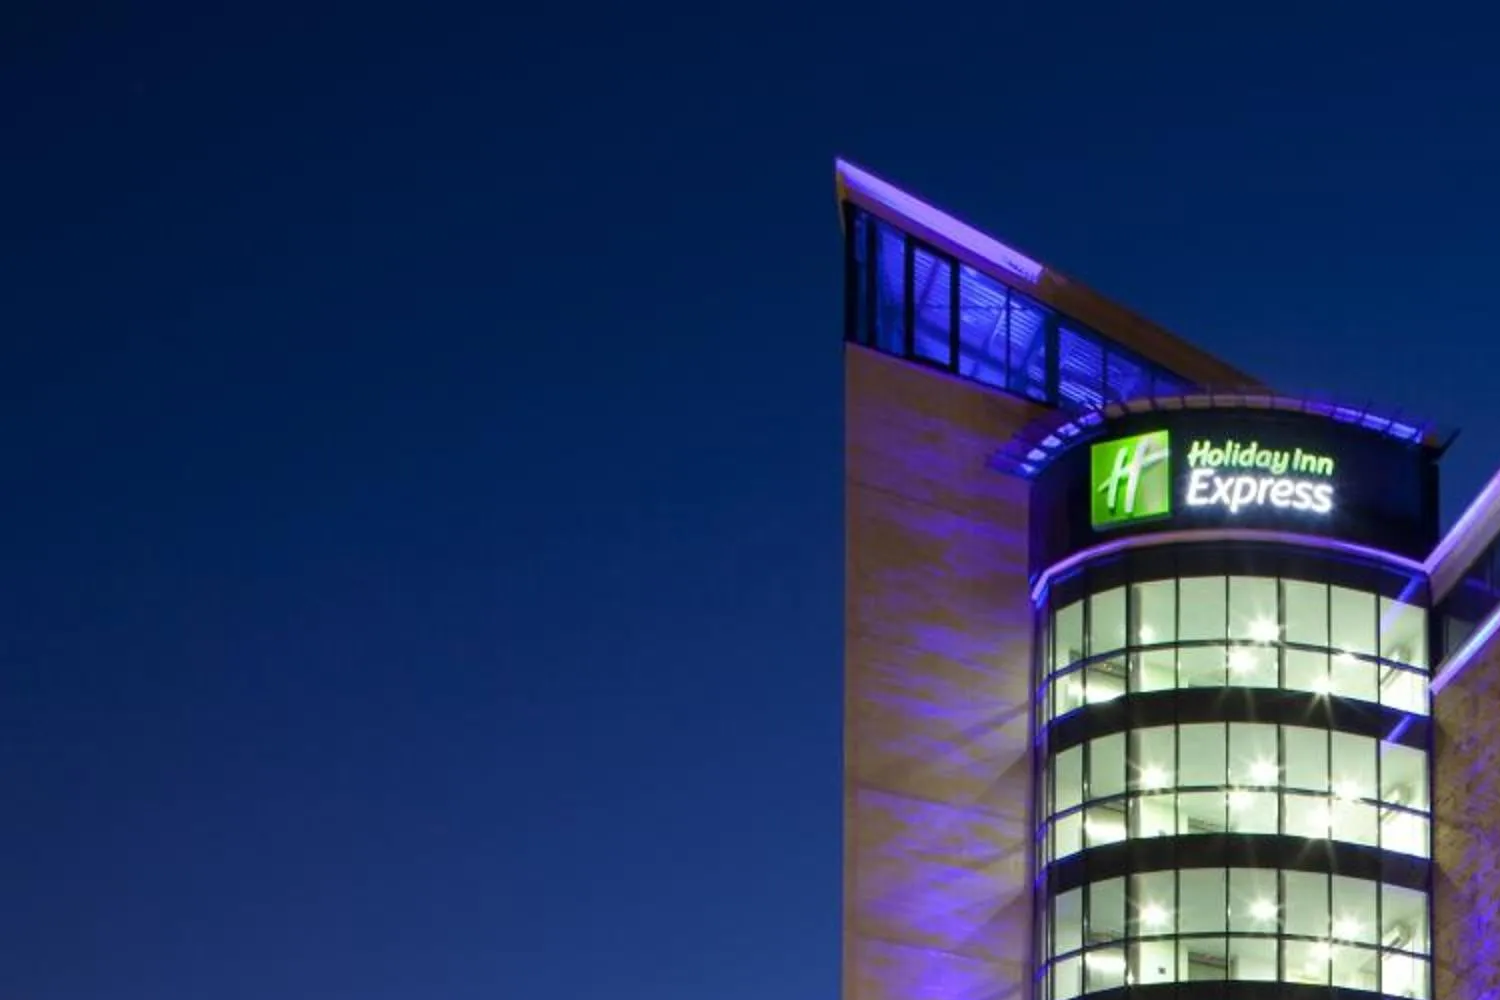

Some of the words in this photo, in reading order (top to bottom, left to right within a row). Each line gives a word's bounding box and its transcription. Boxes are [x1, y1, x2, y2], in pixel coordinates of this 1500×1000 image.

[1187, 440, 1289, 475] Holiday
[1292, 449, 1334, 476] Inn
[1185, 468, 1335, 514] Express
